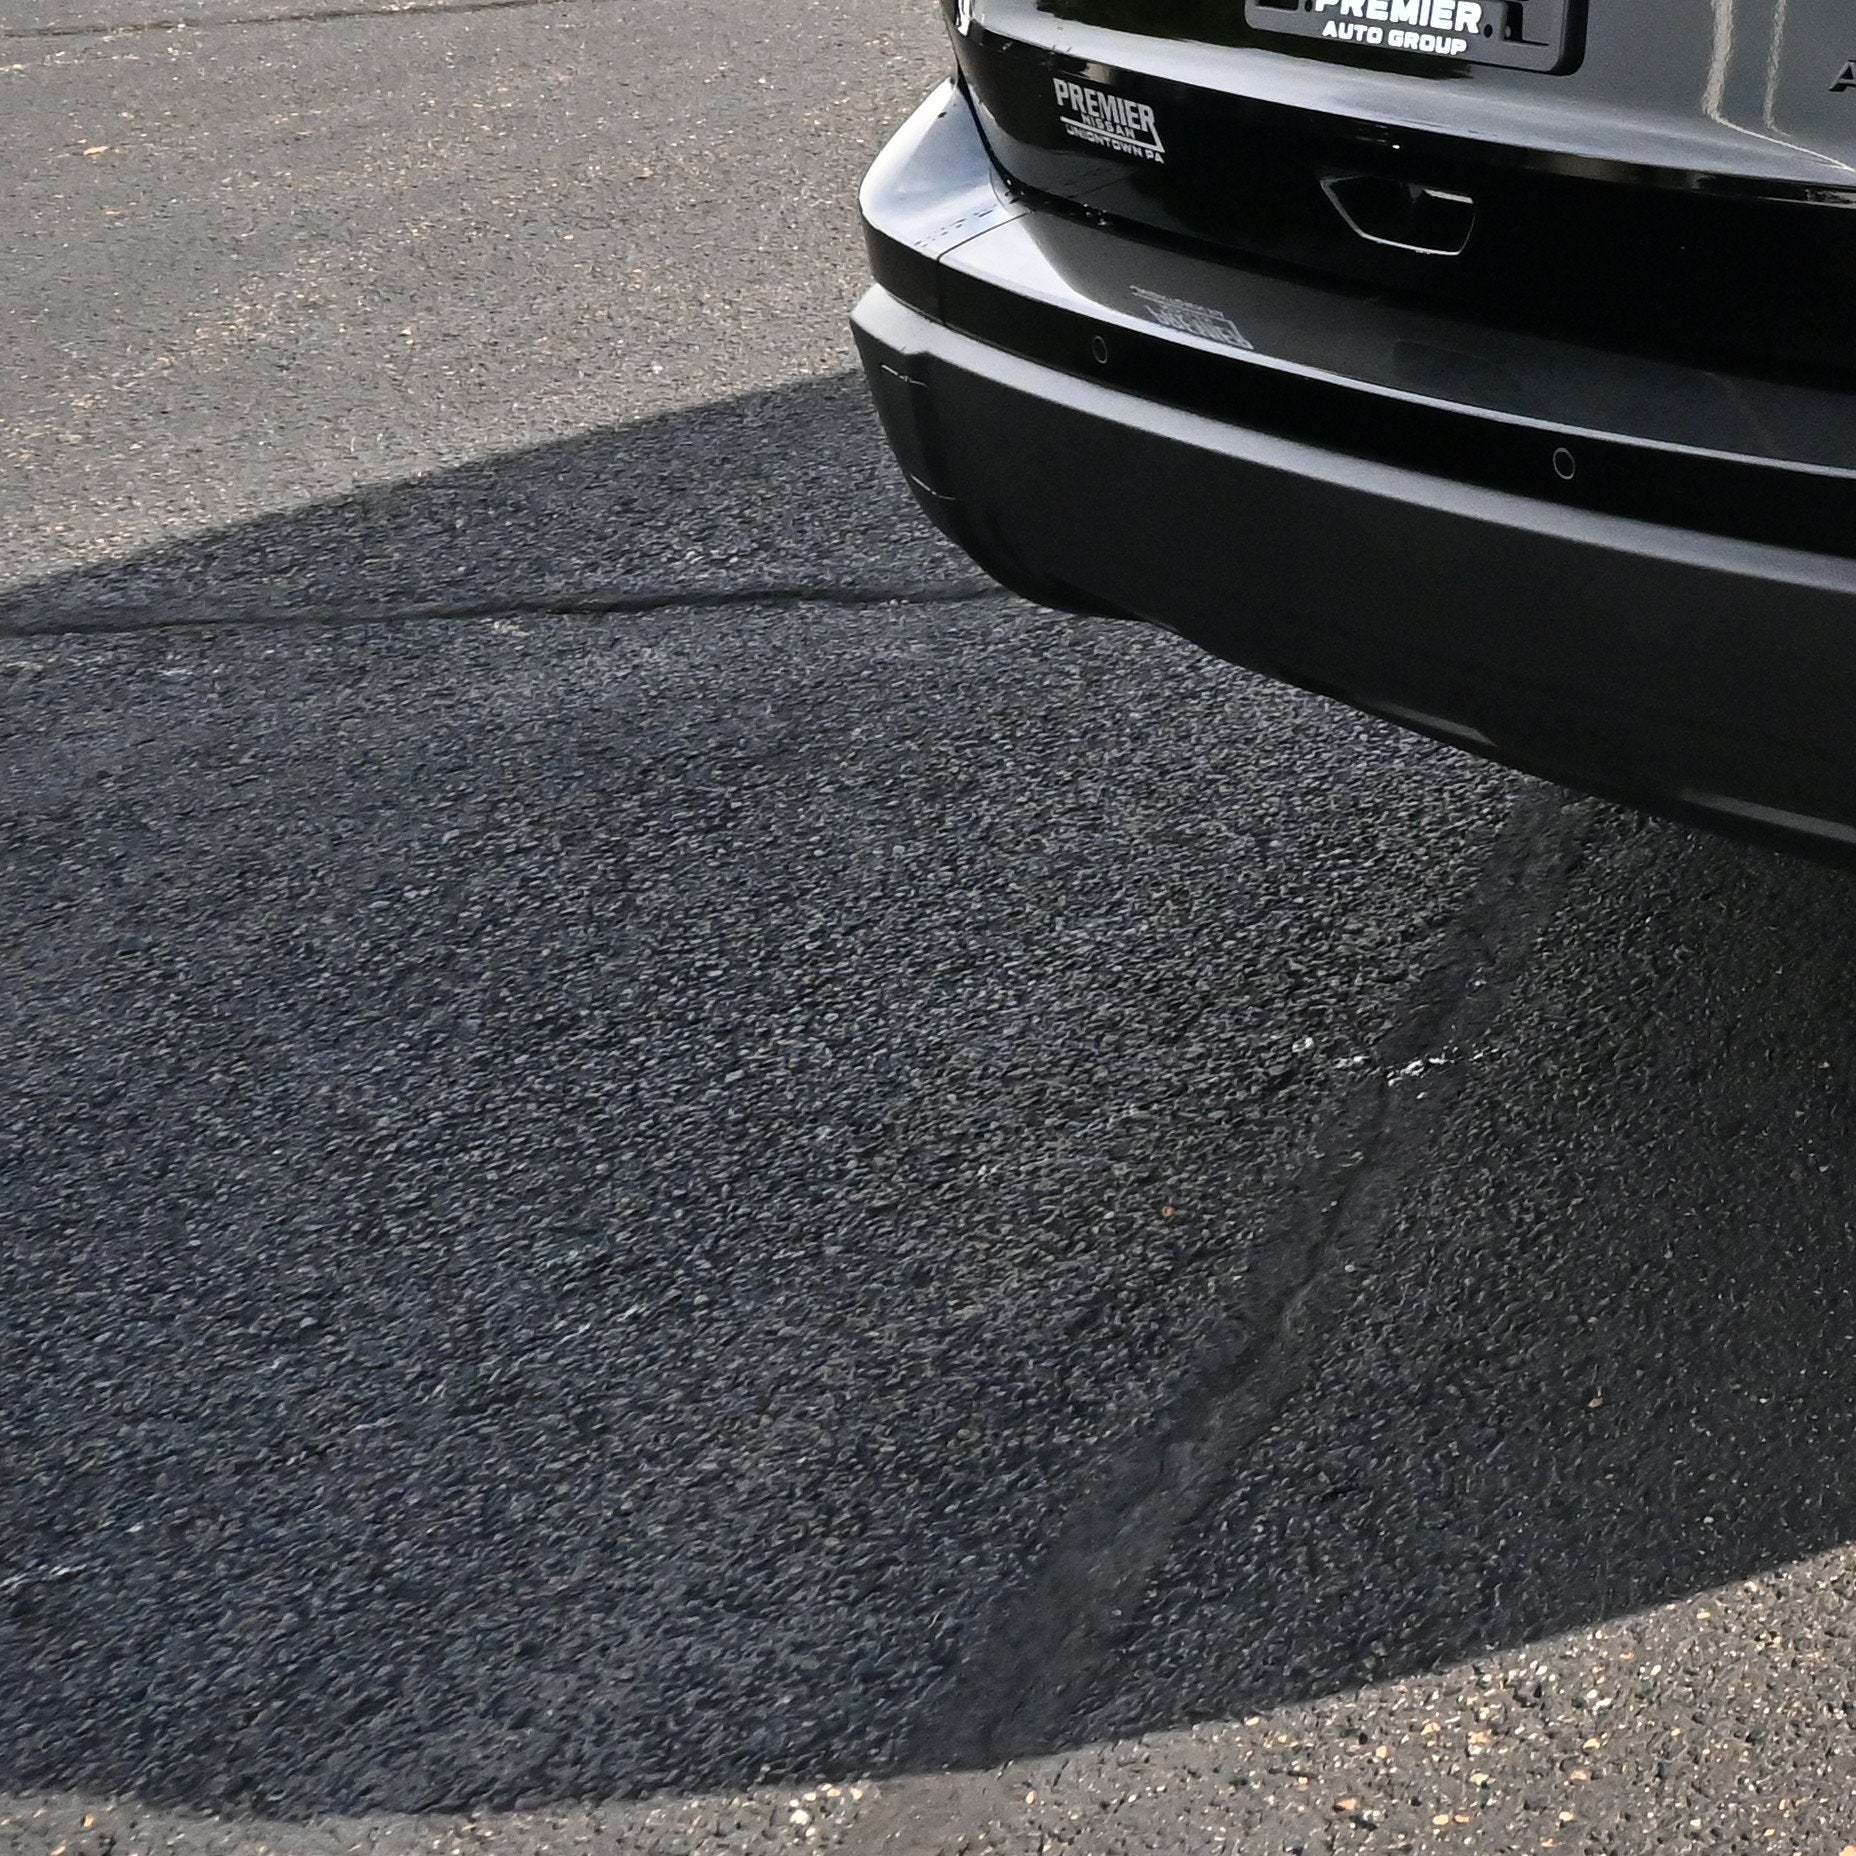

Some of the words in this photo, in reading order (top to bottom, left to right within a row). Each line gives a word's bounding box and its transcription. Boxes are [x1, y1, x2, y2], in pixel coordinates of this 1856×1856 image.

[1321, 20, 1383, 45] AUTO
[1387, 29, 1468, 56] GROUP
[1052, 77, 1155, 132] PREMIER
[1081, 113, 1136, 140] NISSAN
